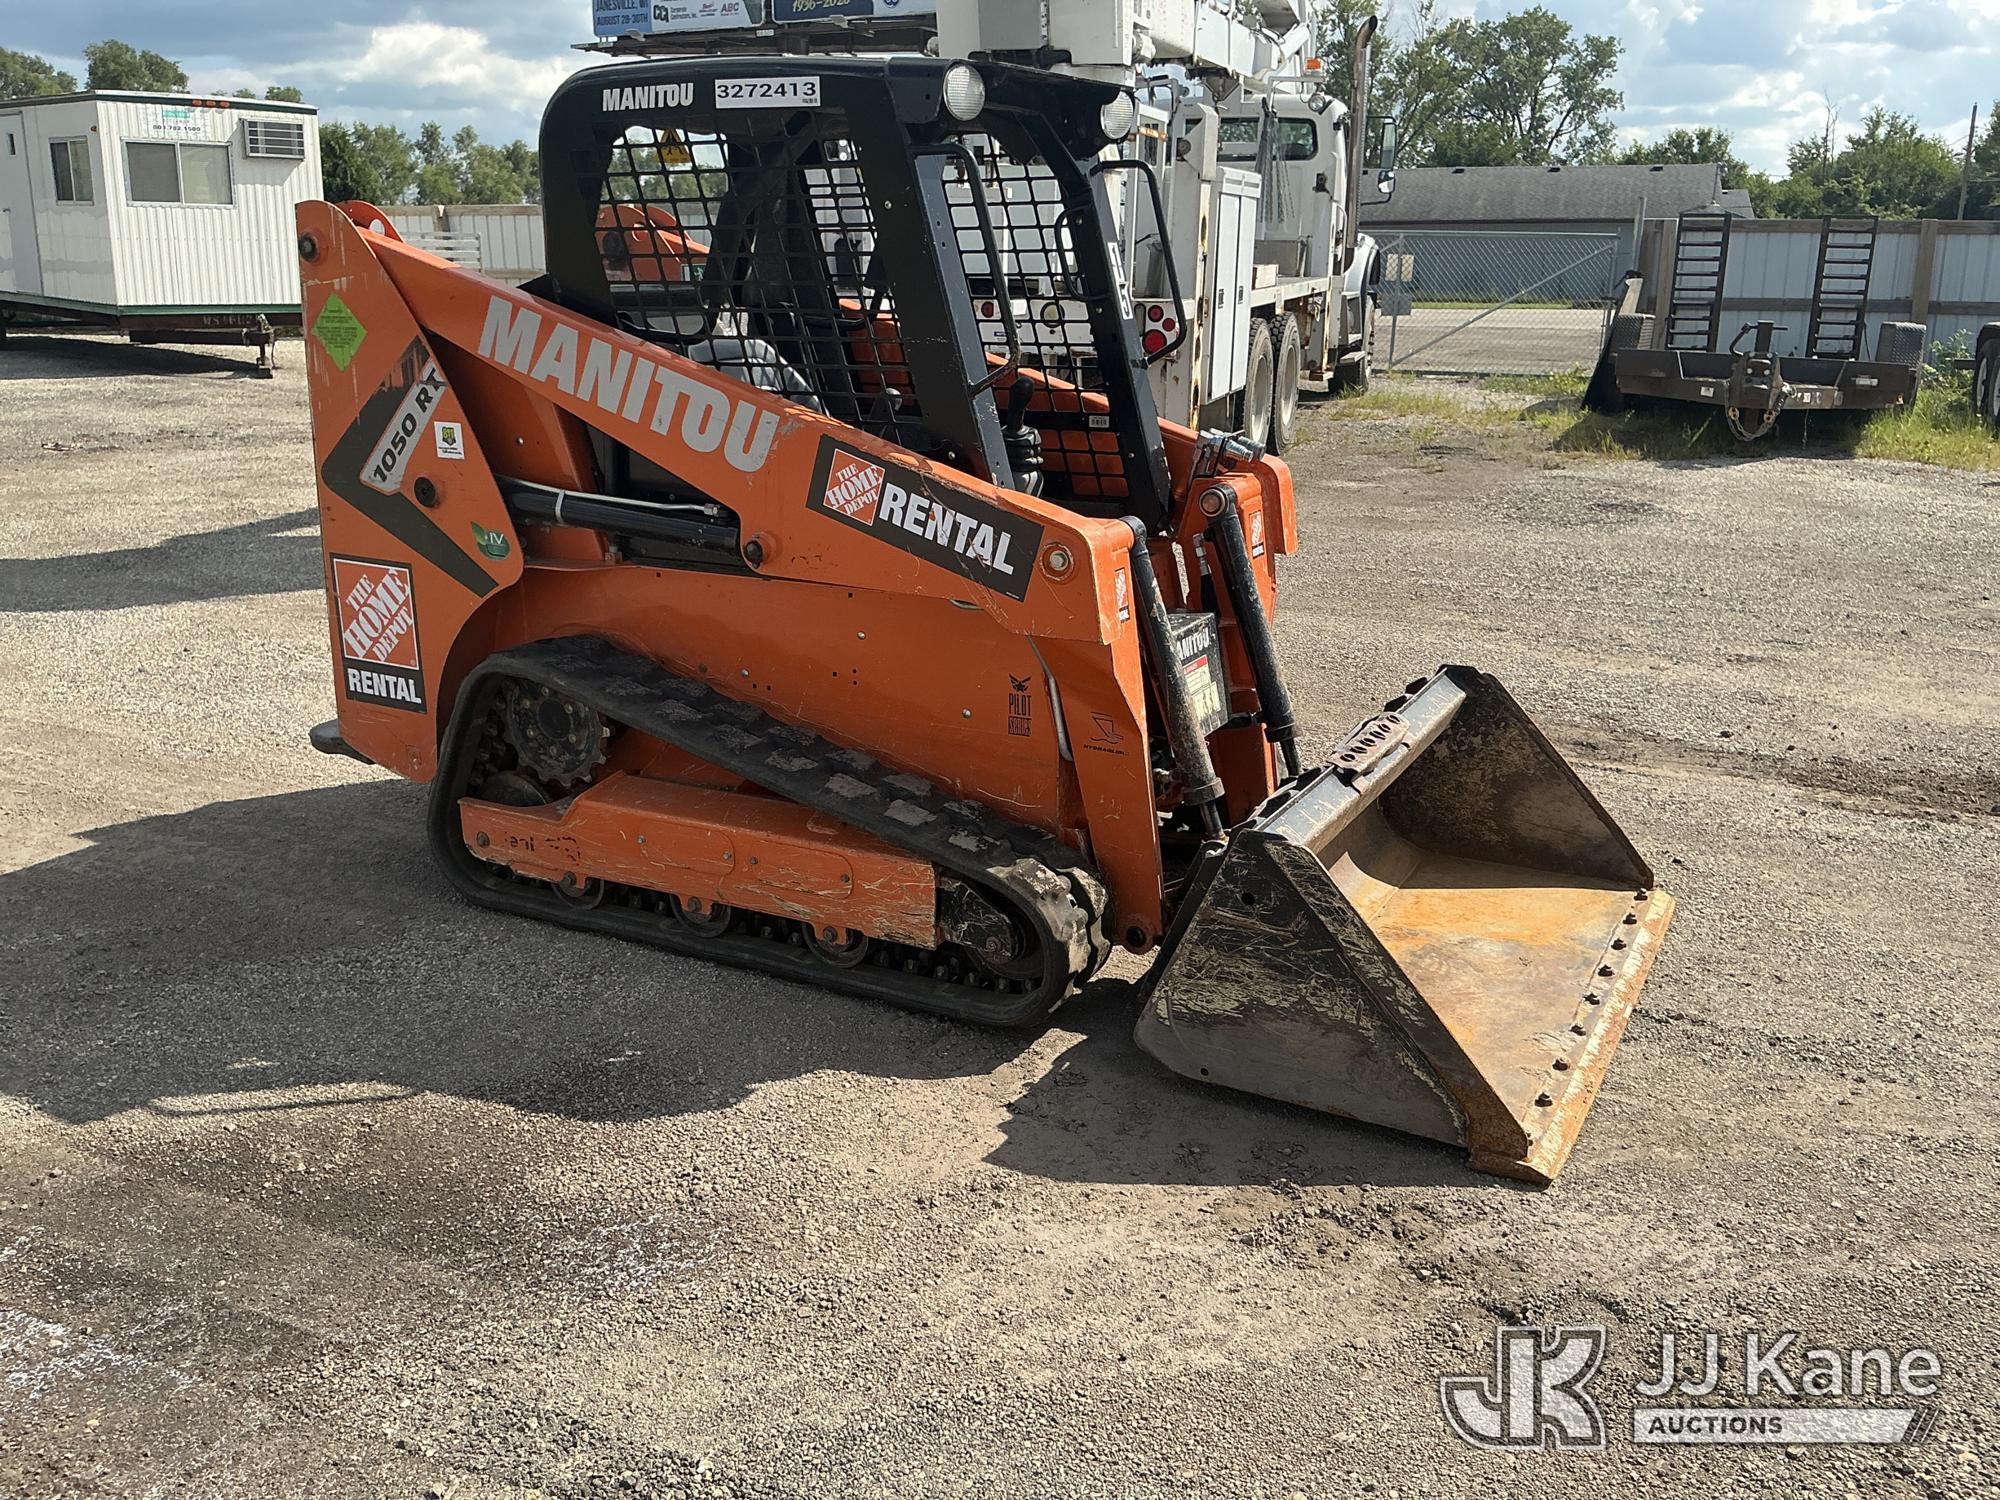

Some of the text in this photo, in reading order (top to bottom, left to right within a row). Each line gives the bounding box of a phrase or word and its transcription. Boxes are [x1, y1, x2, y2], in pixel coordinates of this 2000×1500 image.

[597, 15, 620, 25] AUGUST
[720, 2, 740, 13] ABC
[602, 83, 694, 112] MANITOU
[717, 82, 817, 98] 3272413
[478, 295, 781, 472] MANITOU
[373, 412, 417, 482] 1050
[826, 465, 883, 509] HOME
[836, 463, 859, 482] THE
[843, 487, 879, 515] DEPOT
[878, 482, 1015, 575] RENTAL
[346, 574, 374, 611] THE
[344, 568, 411, 658] HOME
[372, 605, 414, 662] DEPOT
[1176, 626, 1210, 661] ANITOU
[347, 667, 422, 704] RENTAL
[1008, 693, 1032, 716] PILOT
